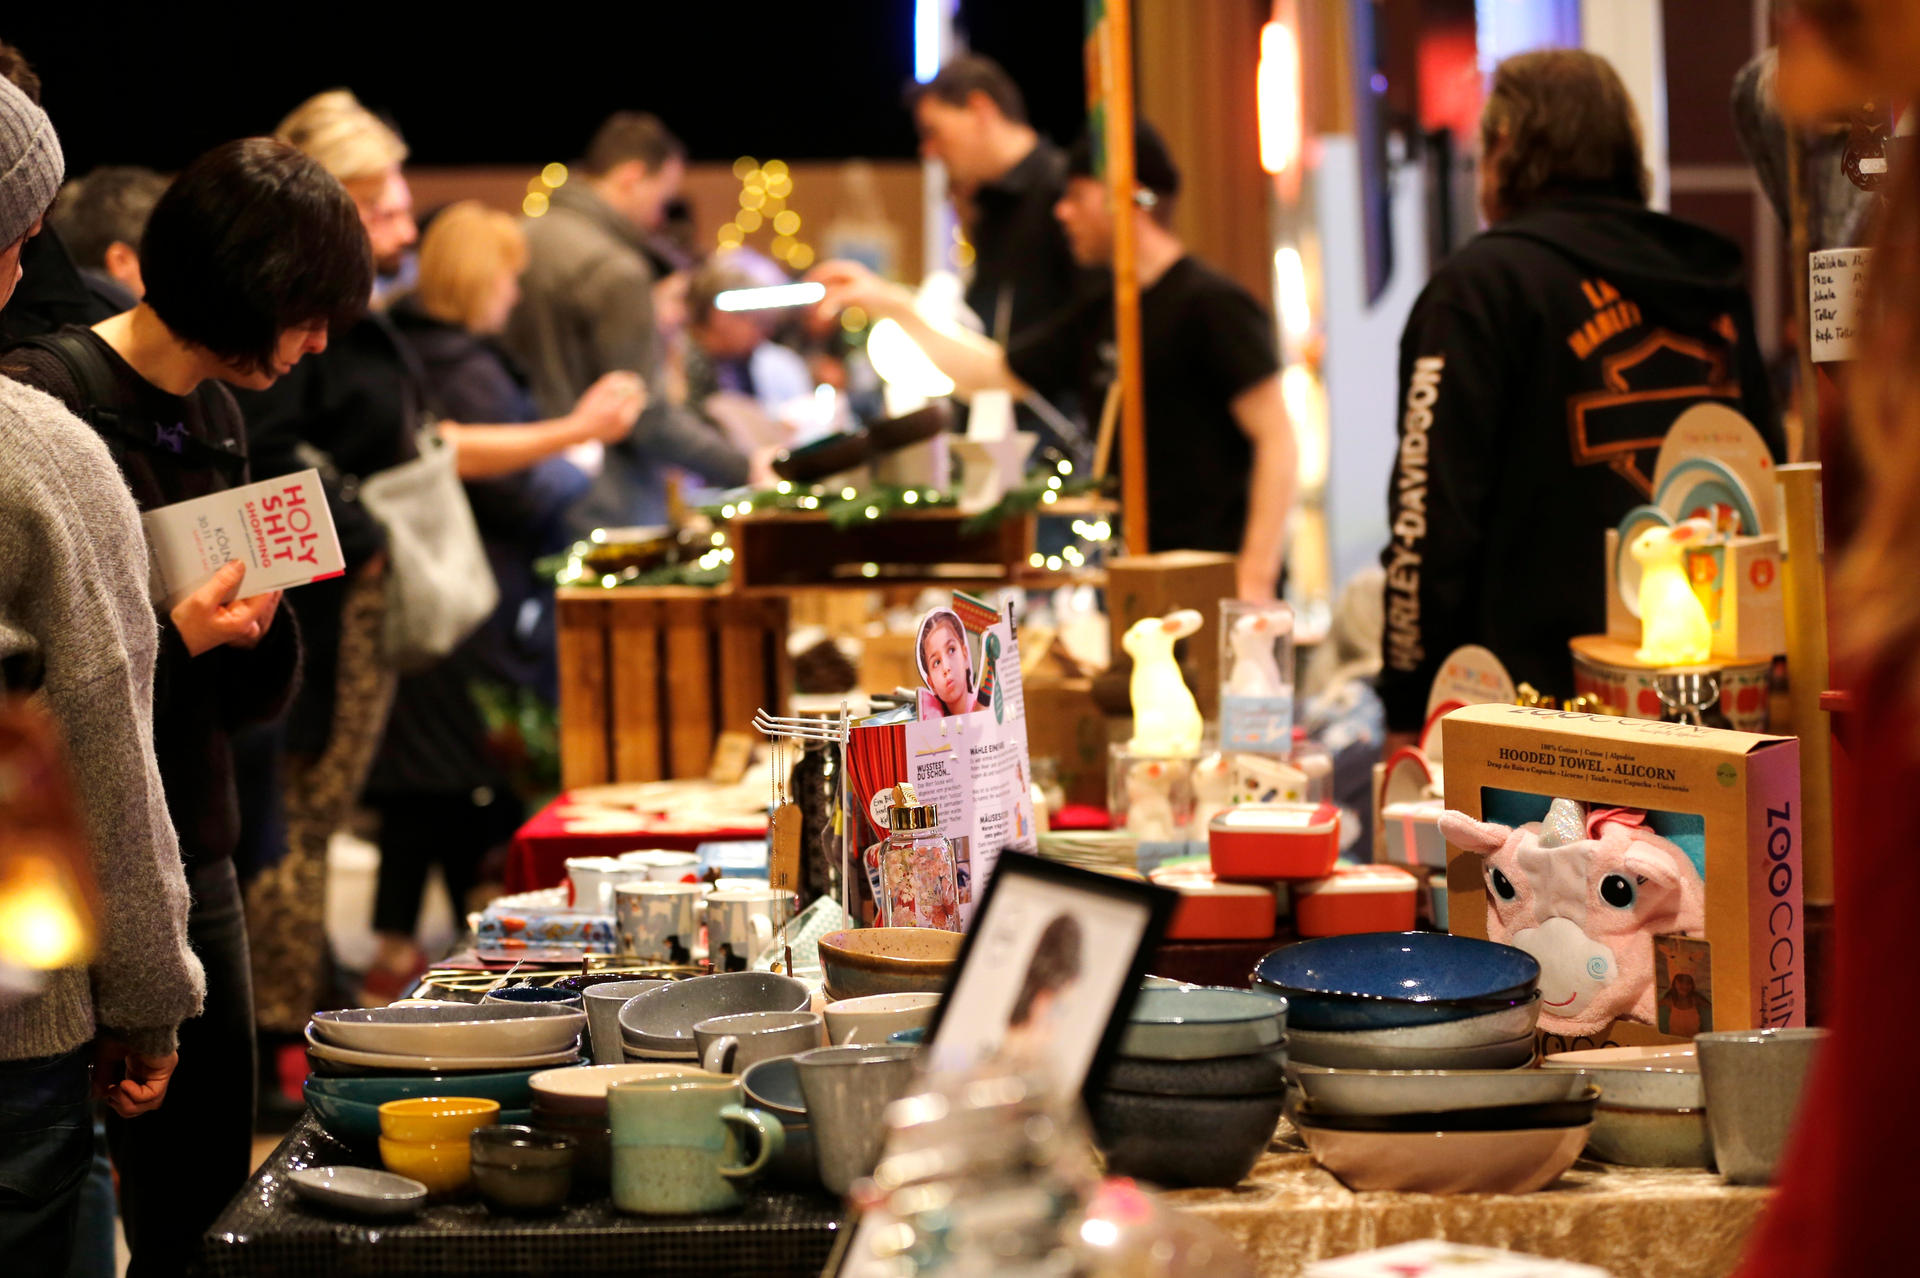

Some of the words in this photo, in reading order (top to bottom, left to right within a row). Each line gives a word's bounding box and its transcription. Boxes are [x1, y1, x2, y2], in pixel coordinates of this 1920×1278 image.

[244, 501, 272, 569] SHOPPING
[262, 495, 294, 561] SHIT
[283, 485, 318, 566] HOLY
[917, 761, 944, 773] WUSSTEST
[917, 772, 926, 781] DU
[1499, 747, 1556, 766] HOODED
[1558, 755, 1604, 773] TOWEL
[1614, 762, 1676, 781] ALICORN
